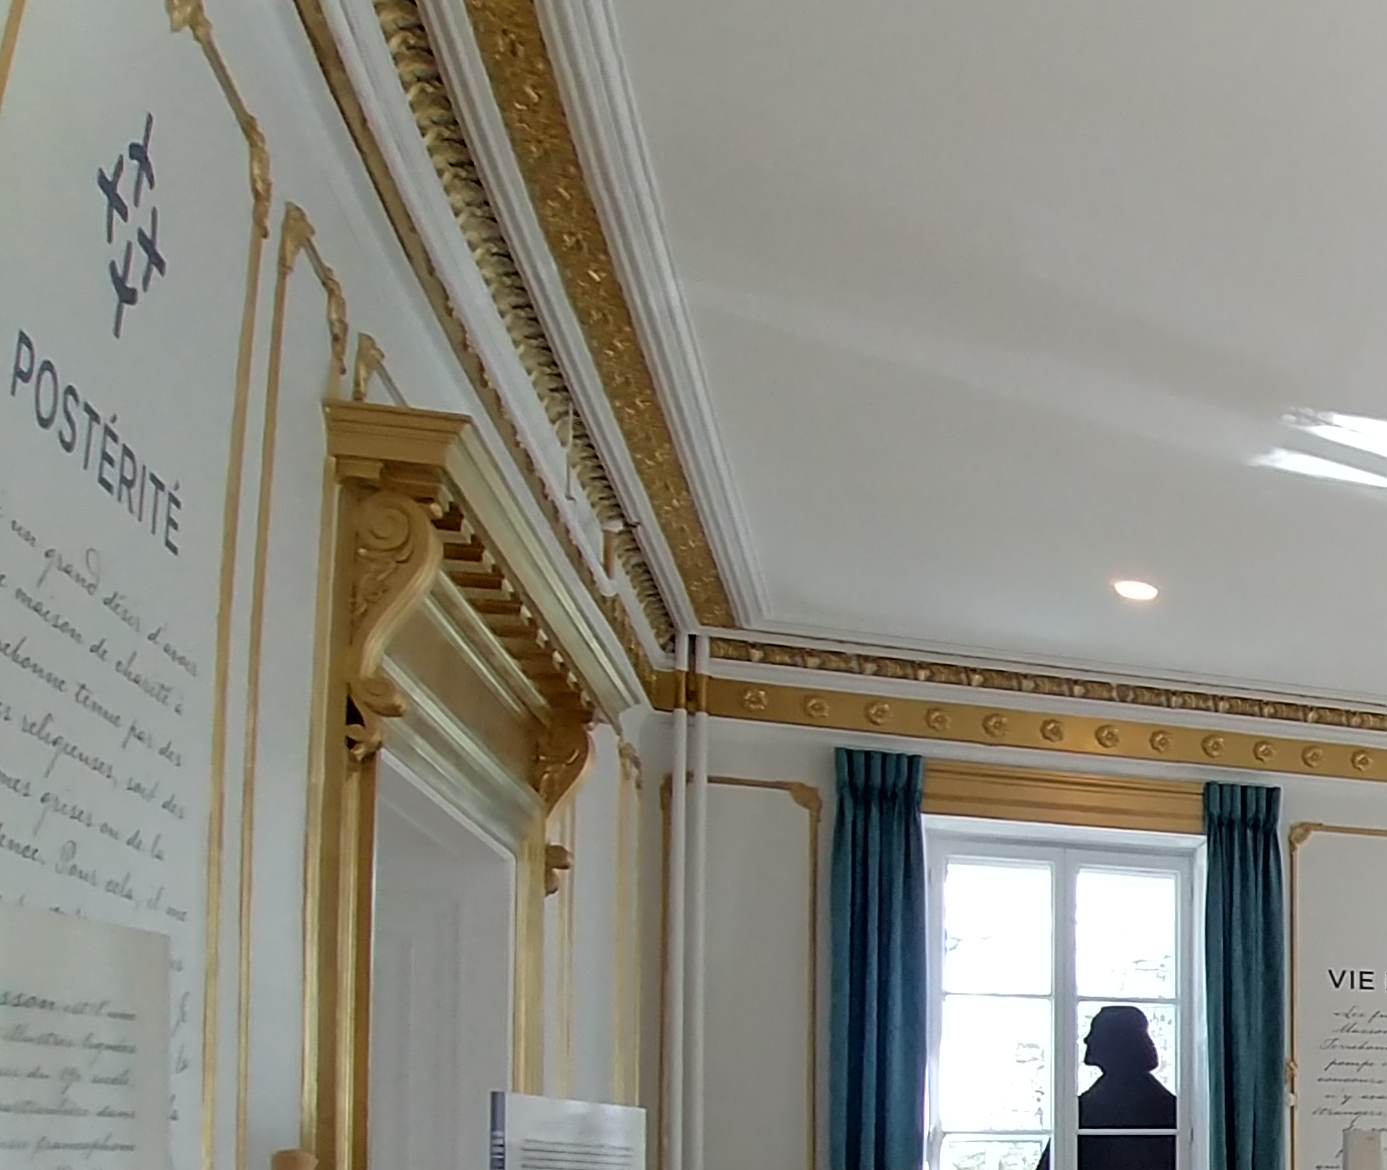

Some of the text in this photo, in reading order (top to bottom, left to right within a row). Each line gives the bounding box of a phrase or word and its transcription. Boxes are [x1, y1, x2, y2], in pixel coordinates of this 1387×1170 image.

[10, 328, 182, 556] POSTÉRITÉ
[15, 588, 83, 644] maison
[90, 638, 108, 662] de
[126, 829, 144, 850] de
[1328, 969, 1375, 991] VIE
